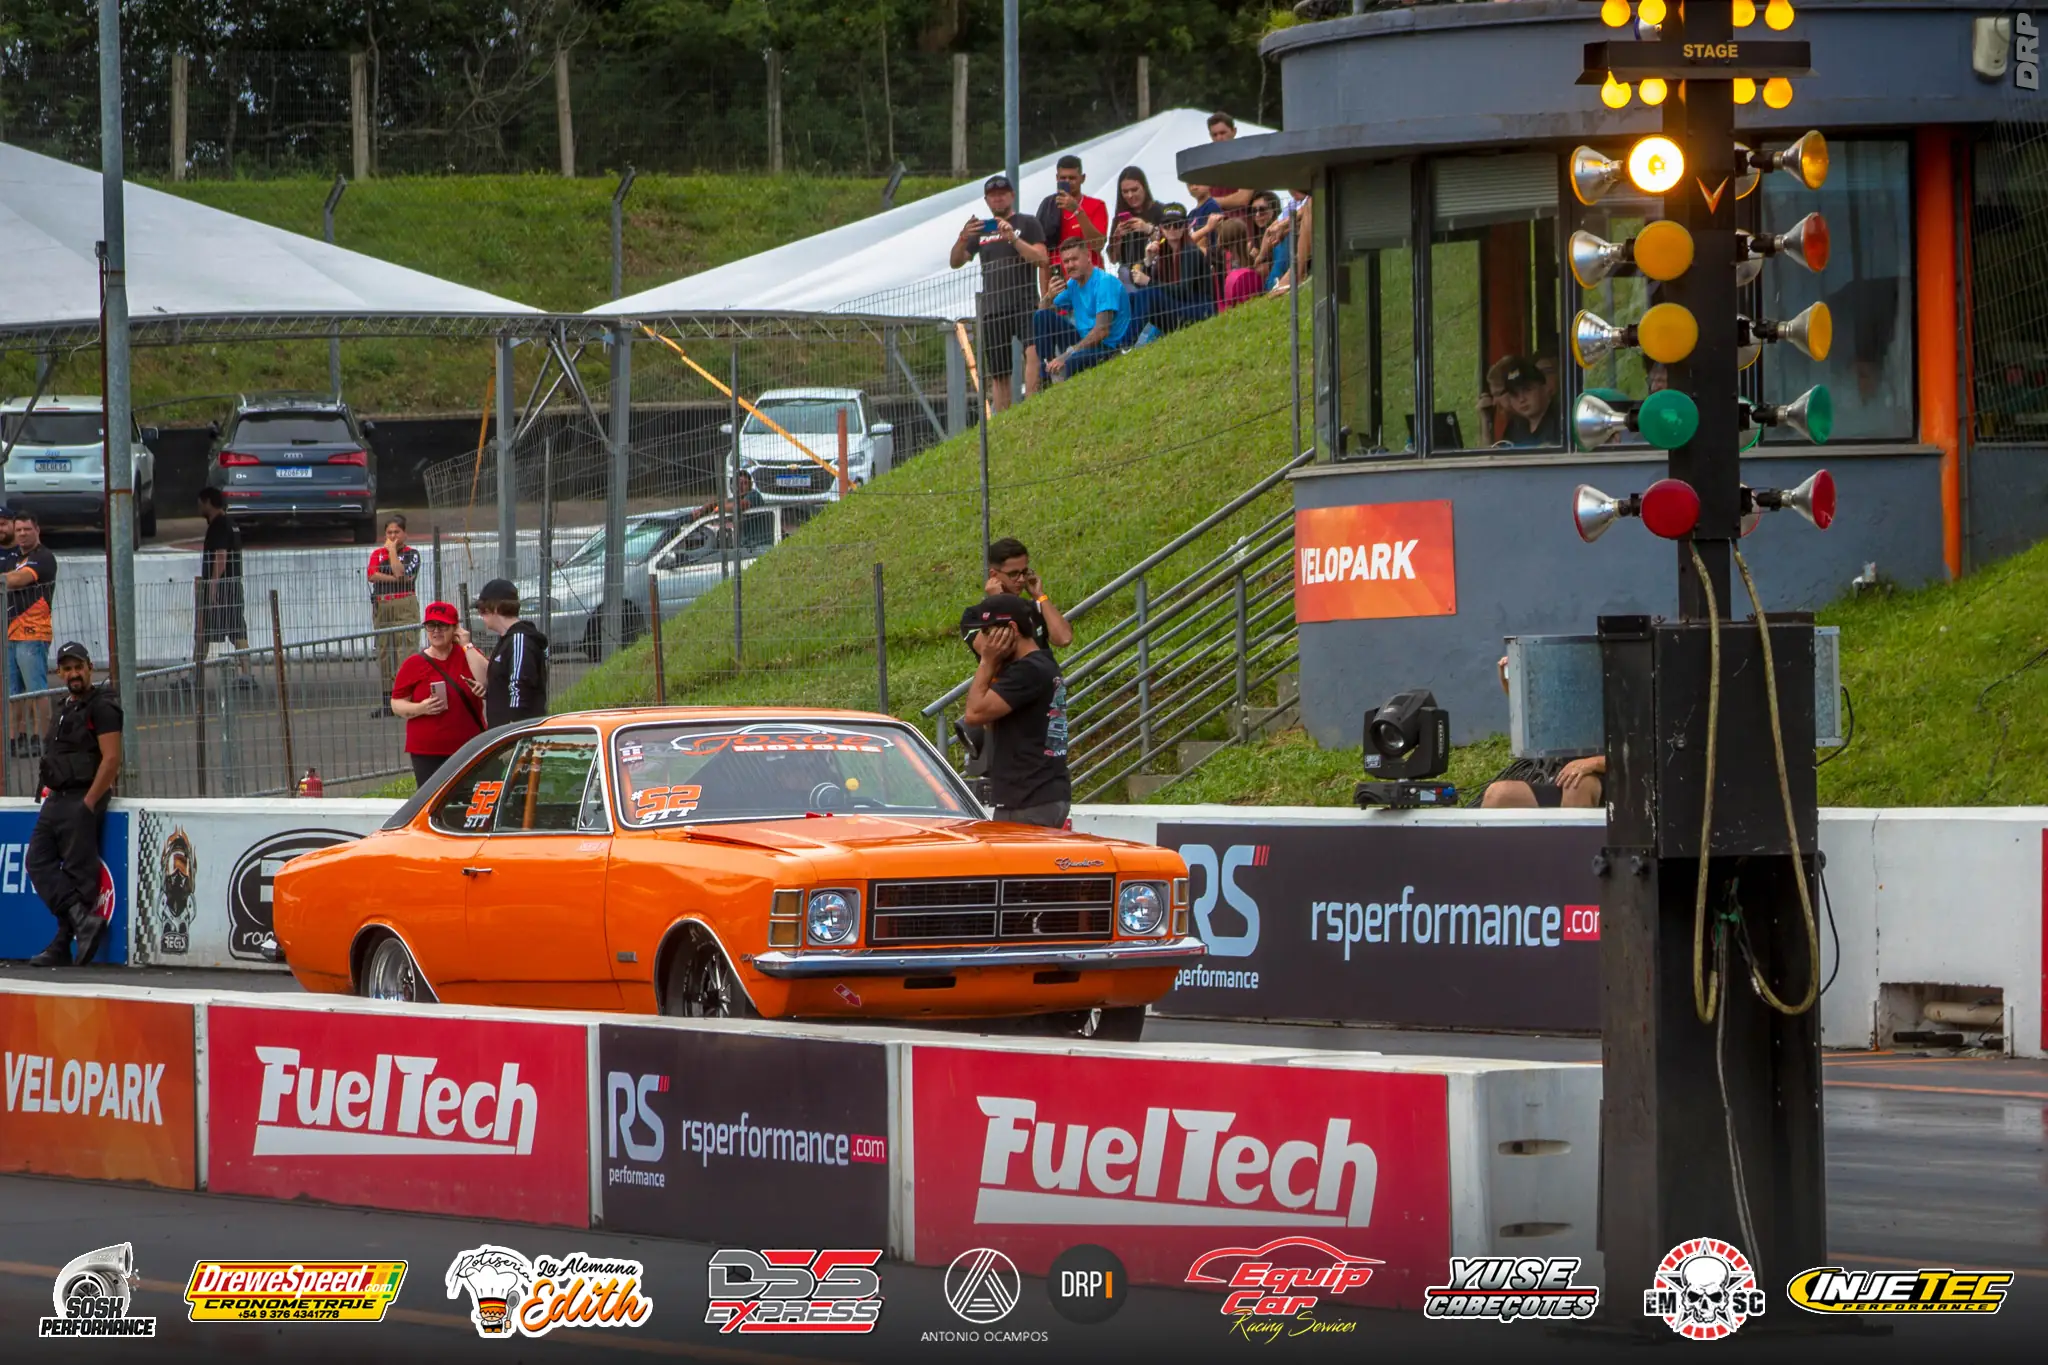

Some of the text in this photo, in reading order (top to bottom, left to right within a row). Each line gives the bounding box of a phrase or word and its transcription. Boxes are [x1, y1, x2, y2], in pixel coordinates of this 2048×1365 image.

[1683, 44, 1739, 58] STAGE
[1301, 539, 1419, 586] VELOPARK
[732, 744, 883, 753] MOTORS
[631, 785, 702, 819] #52
[640, 806, 697, 825] STT
[464, 815, 490, 828] STT
[5, 1052, 165, 1126] VELOPARK
[255, 1046, 537, 1155] FuelTech
[608, 1071, 665, 1162] RS
[609, 1165, 665, 1187] performance
[977, 1096, 1378, 1227] FuelTech
